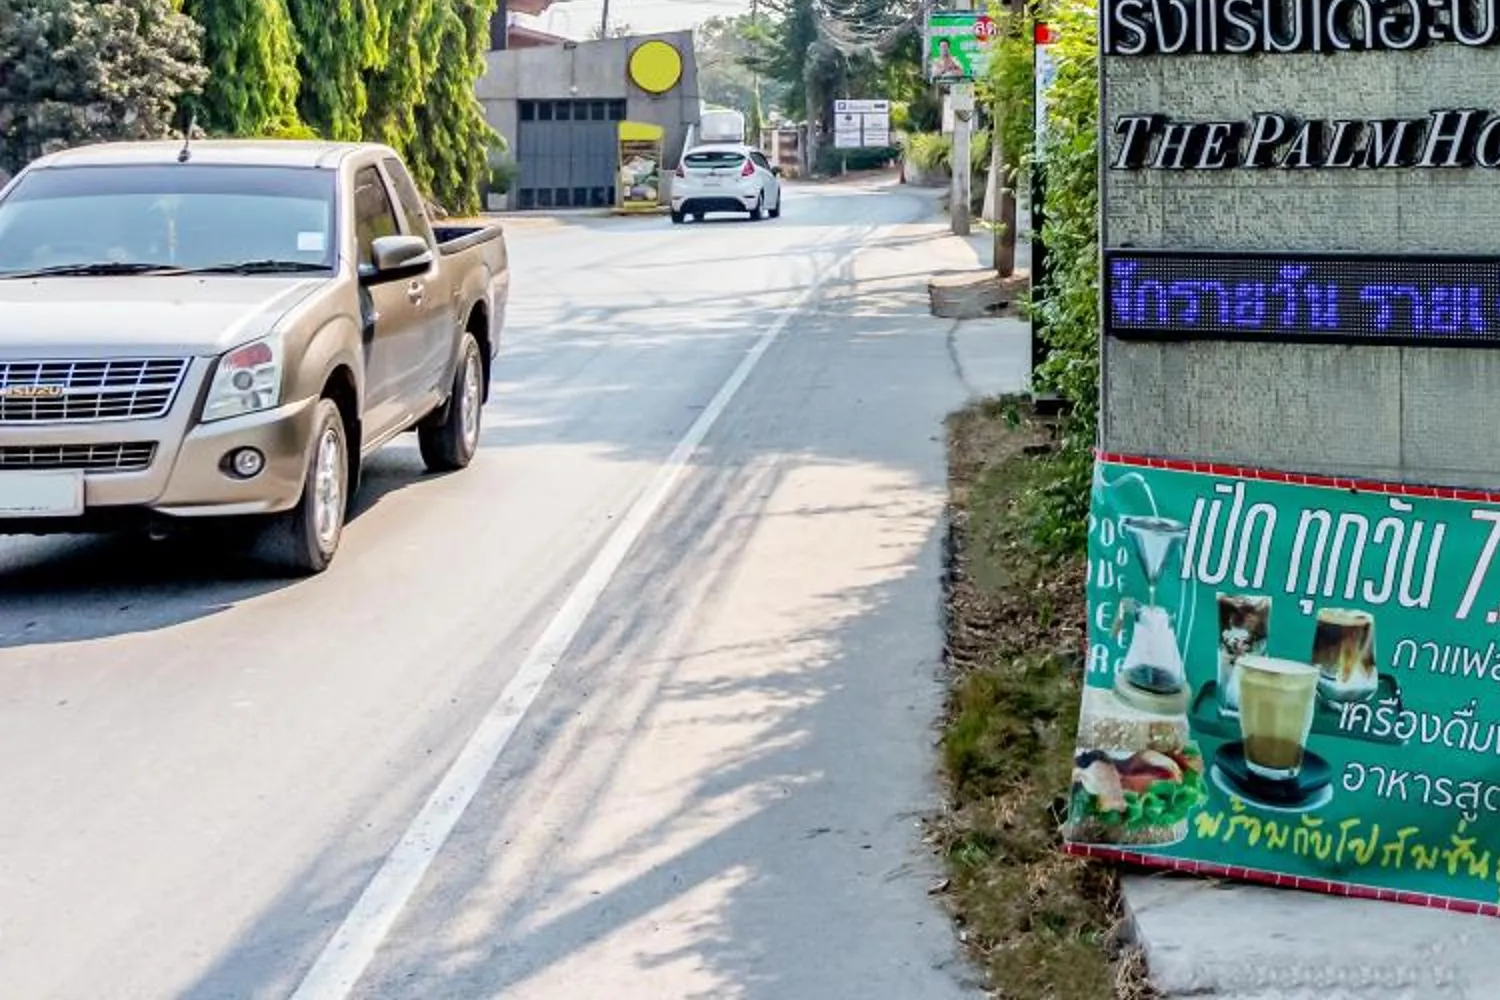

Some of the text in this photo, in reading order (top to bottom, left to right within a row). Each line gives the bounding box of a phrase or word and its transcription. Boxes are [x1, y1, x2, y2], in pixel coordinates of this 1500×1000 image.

[1111, 114, 1236, 170] THE
[1244, 111, 1414, 169] PALM
[1179, 480, 1278, 588] เปิด
[1285, 499, 1446, 616] ทุกวัน
